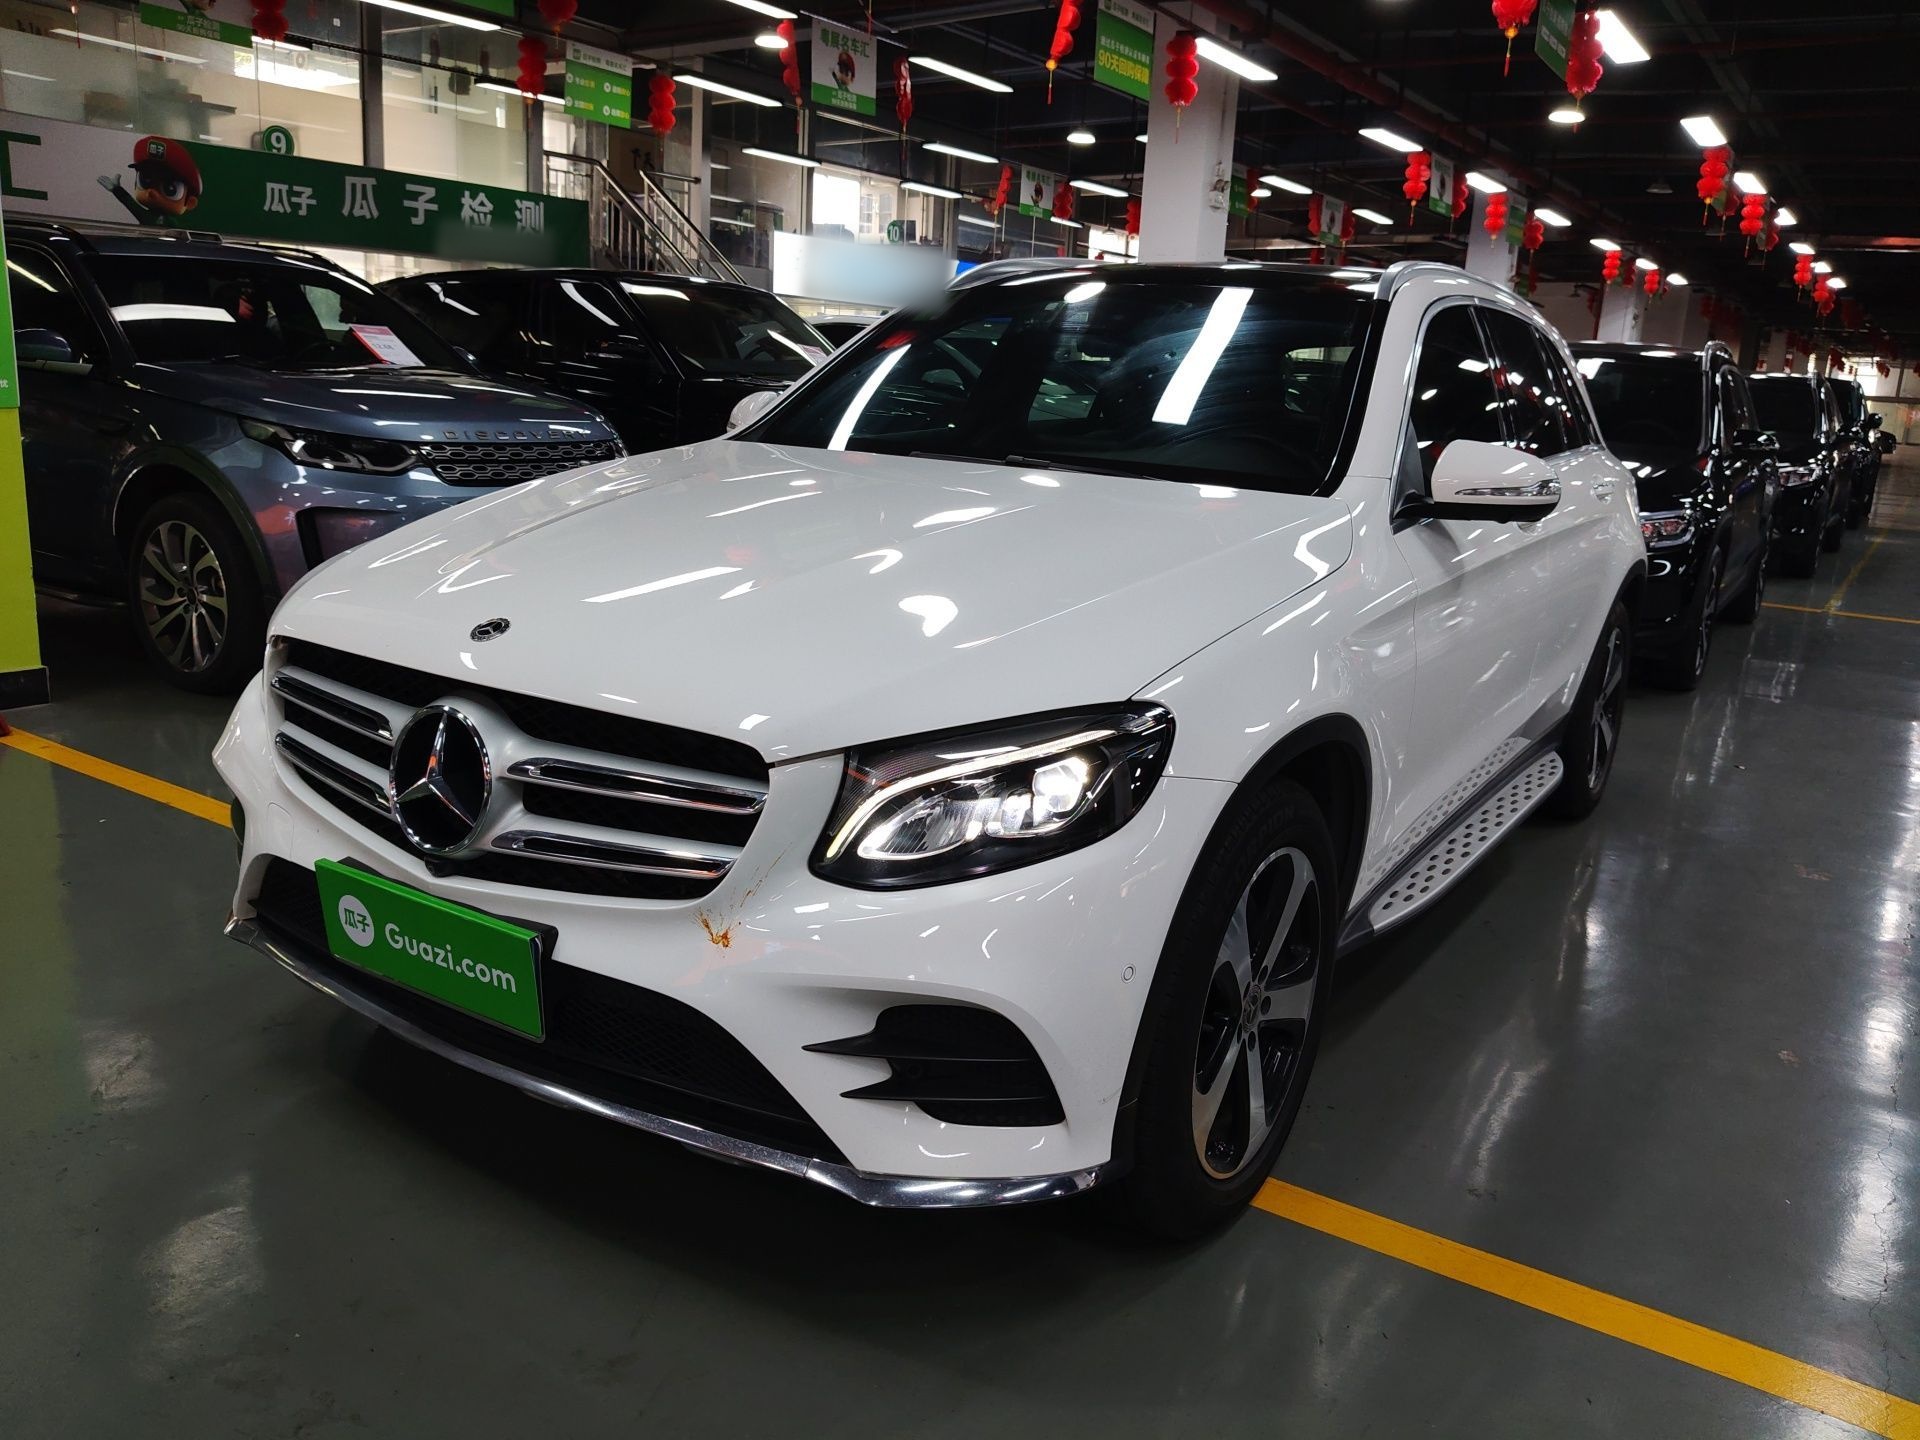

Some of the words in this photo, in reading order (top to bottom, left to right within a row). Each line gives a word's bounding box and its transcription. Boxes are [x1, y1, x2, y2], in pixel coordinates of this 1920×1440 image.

[269, 131, 287, 155] 9
[263, 182, 317, 217] 瓜子
[342, 175, 545, 236] 瓜子检测
[888, 224, 900, 242] 10
[442, 429, 589, 441] DISCOVERY
[343, 907, 370, 933] 瓜子
[384, 922, 517, 994] Guazi.com
